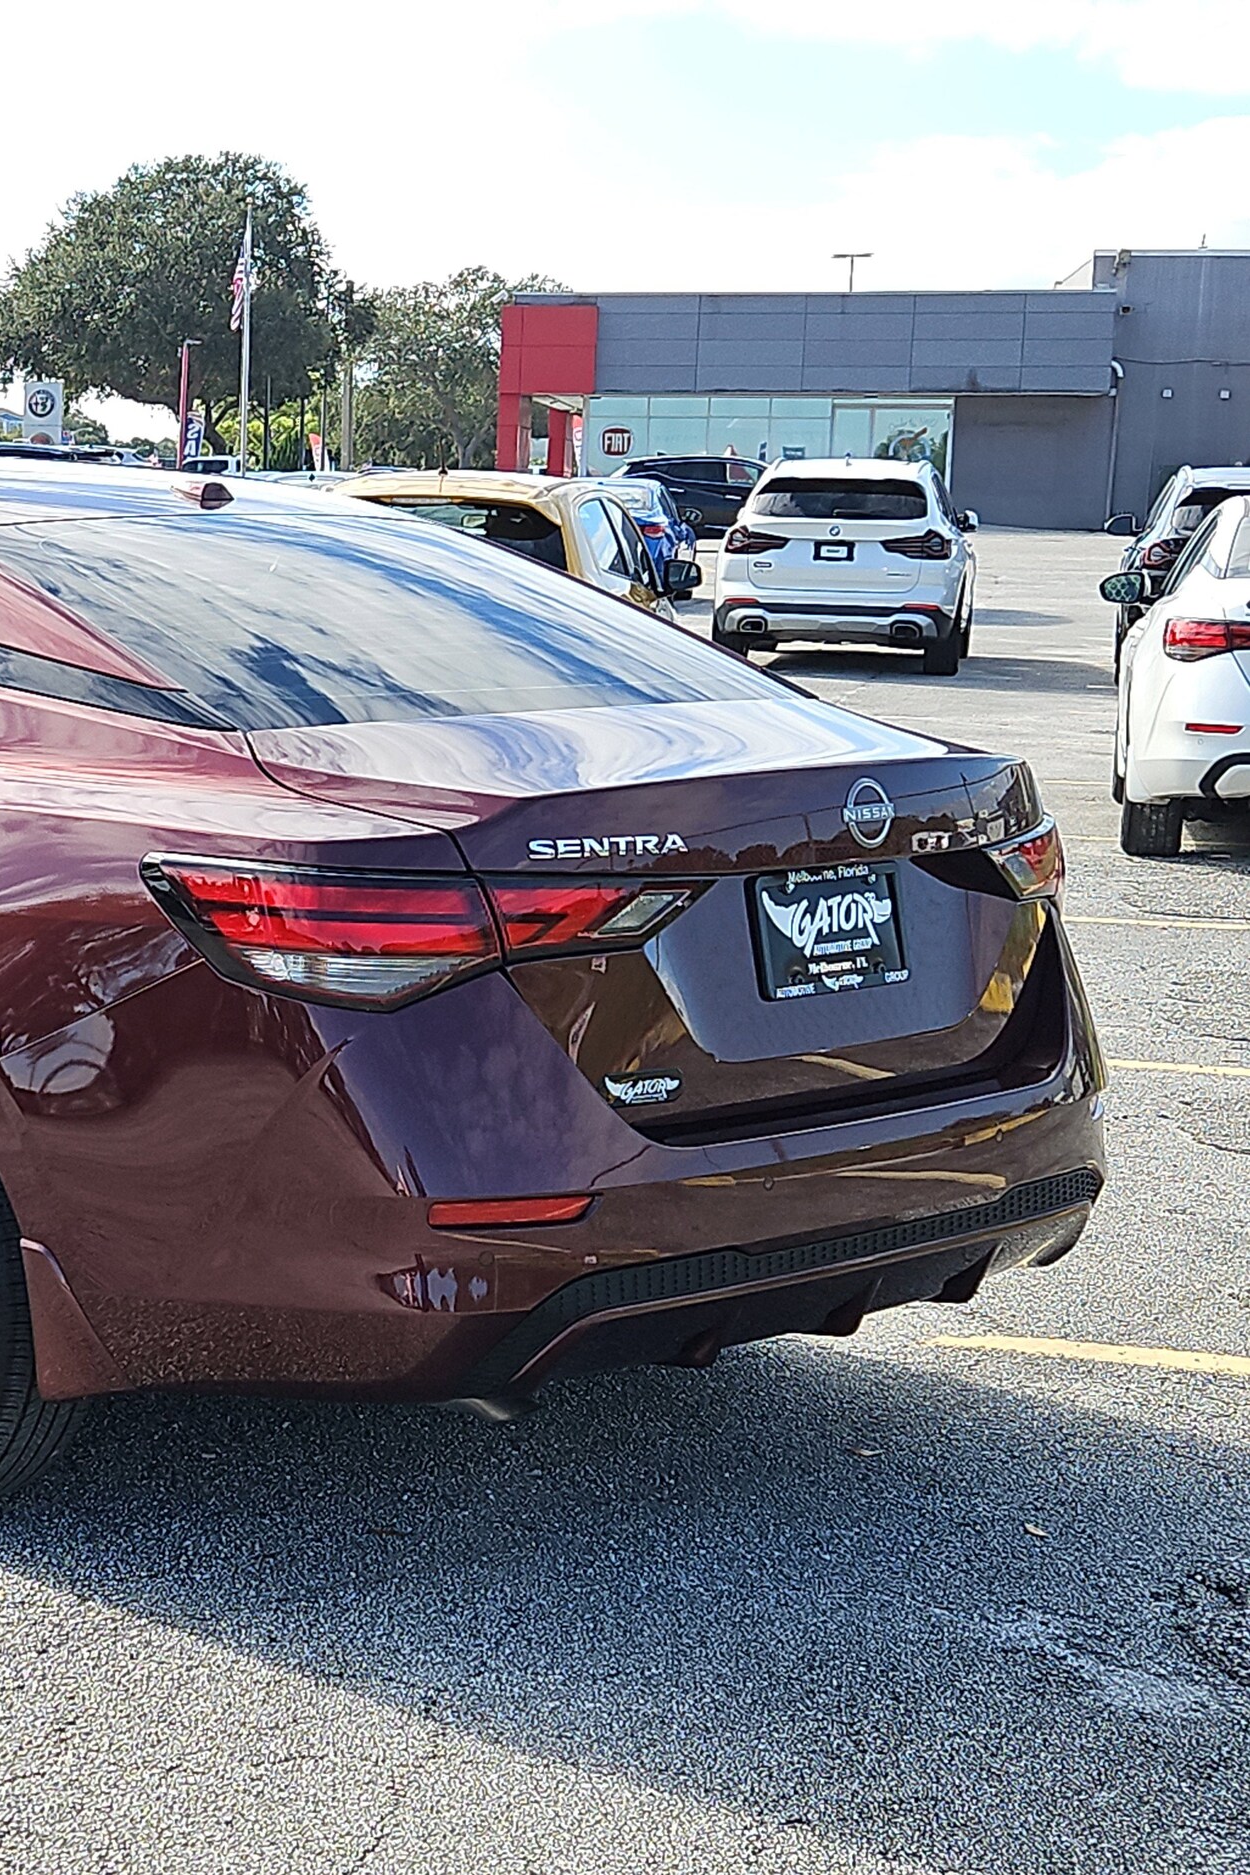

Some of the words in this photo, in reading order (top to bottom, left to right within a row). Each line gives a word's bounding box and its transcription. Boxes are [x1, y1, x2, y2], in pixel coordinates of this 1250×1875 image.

[604, 433, 631, 453] FIAT
[843, 803, 896, 822] NISSAN
[529, 834, 689, 860] SENTRA
[837, 864, 869, 879] Florida
[792, 891, 881, 959] GATOR
[884, 969, 909, 984] GROUP
[620, 1078, 668, 1105] GATOR
